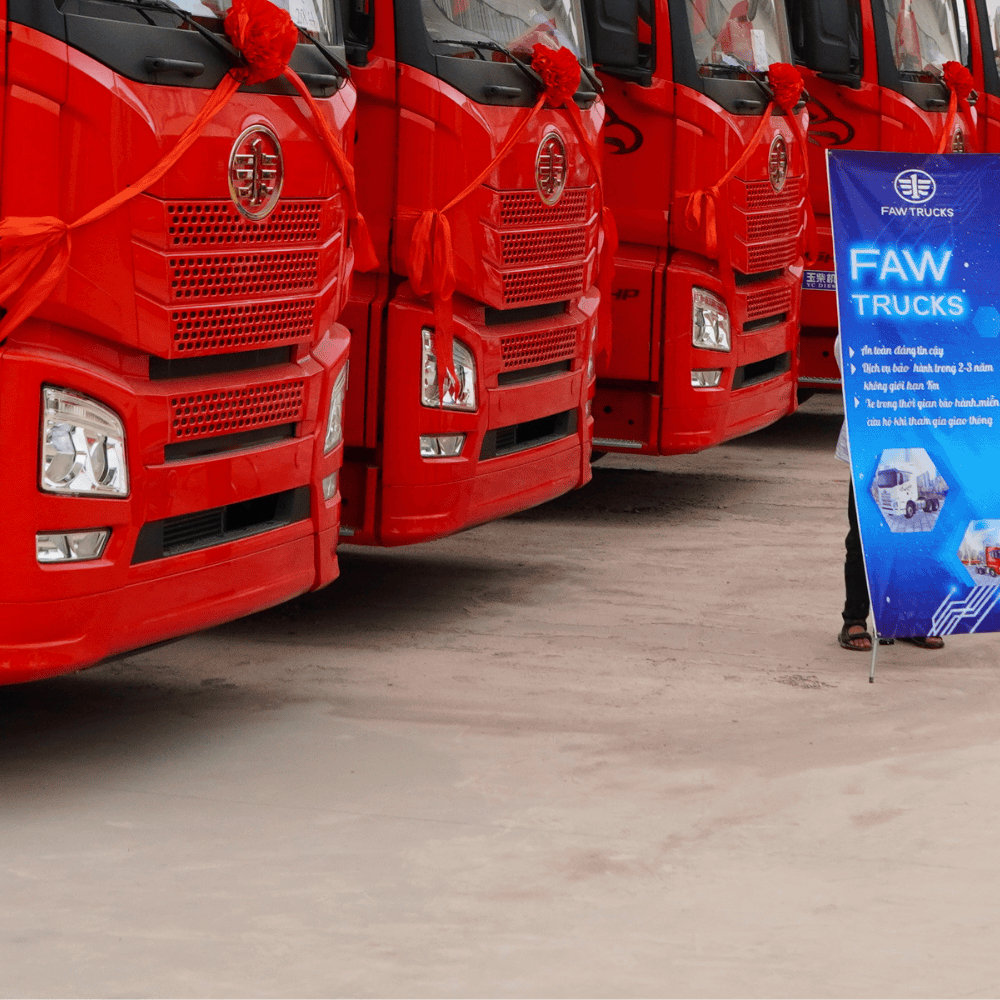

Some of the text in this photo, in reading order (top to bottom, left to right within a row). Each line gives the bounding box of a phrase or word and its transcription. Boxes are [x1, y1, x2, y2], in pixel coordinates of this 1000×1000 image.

[881, 206, 954, 217] FAW TRUCKS
[850, 248, 952, 282] FAW
[851, 294, 964, 316] TRUCKS
